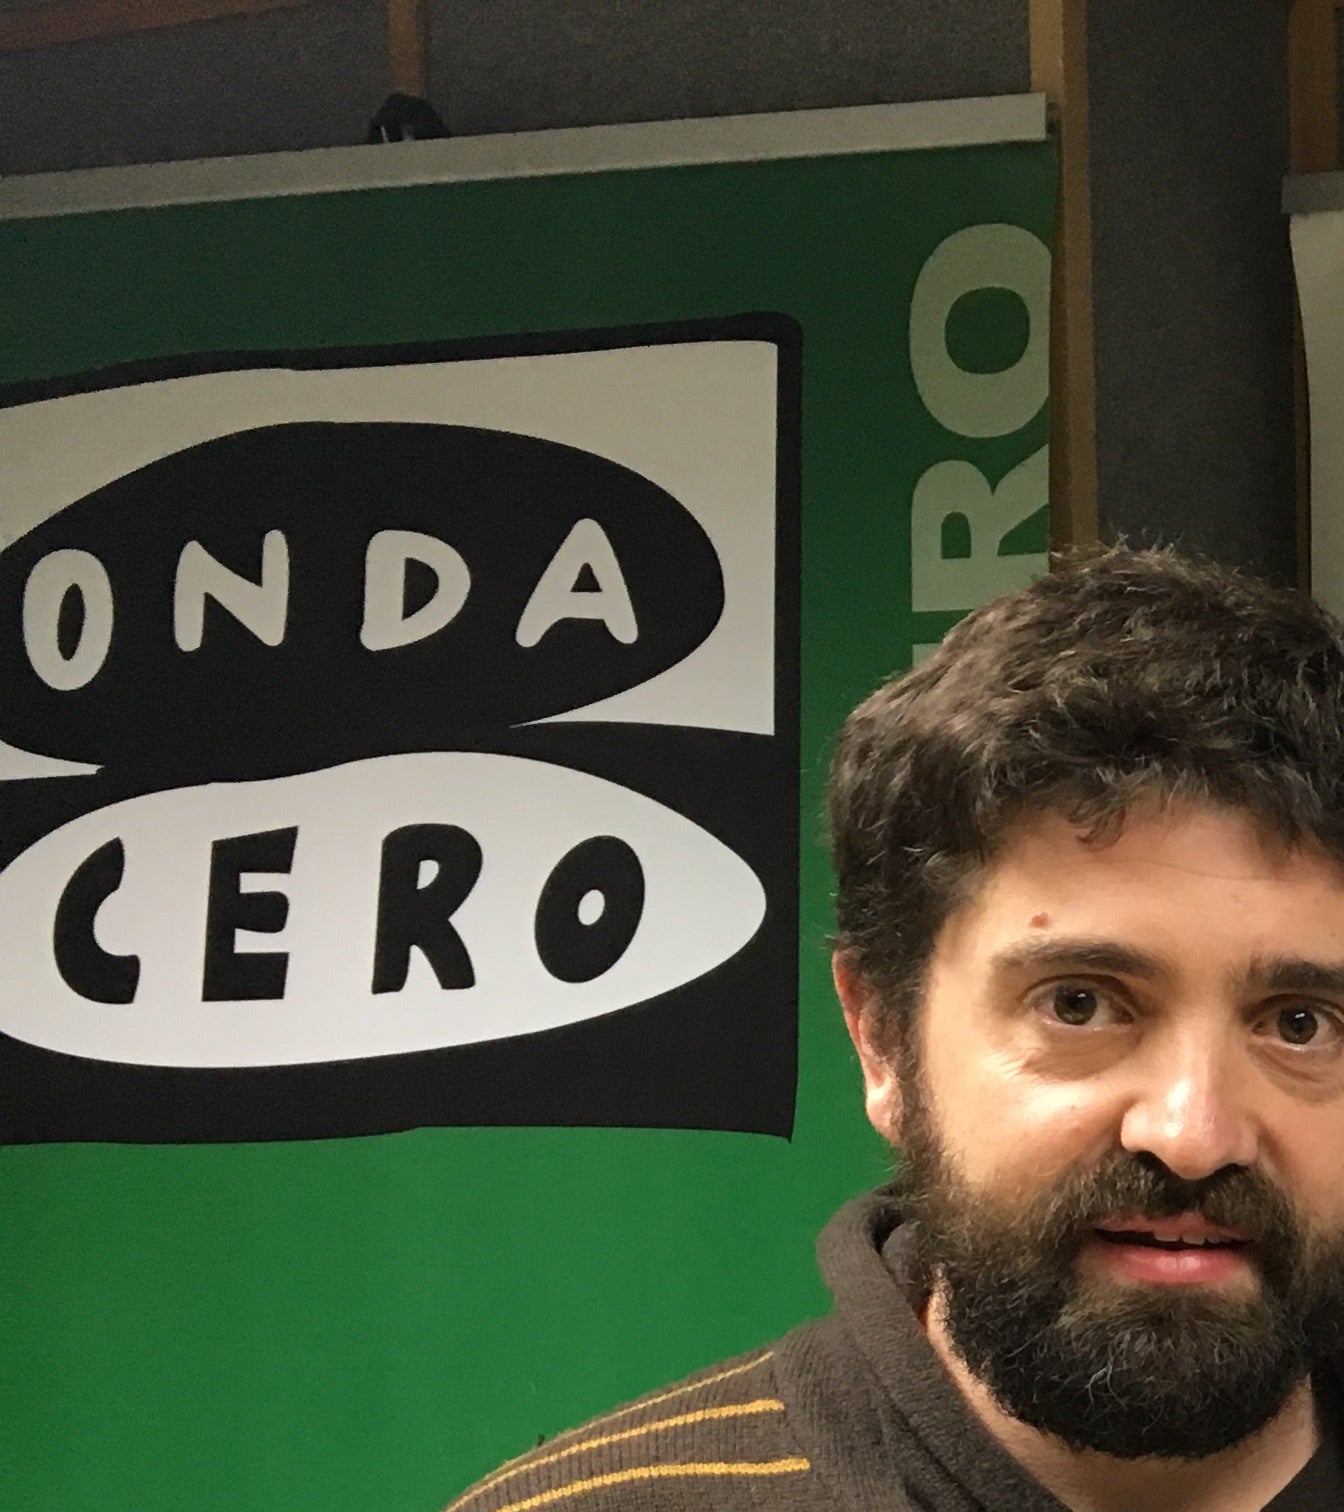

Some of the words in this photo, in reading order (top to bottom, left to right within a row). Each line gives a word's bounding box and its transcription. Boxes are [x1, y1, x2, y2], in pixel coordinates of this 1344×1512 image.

[909, 223, 1051, 670] RO
[22, 518, 638, 691] ONDA
[53, 823, 645, 1004] CERO
